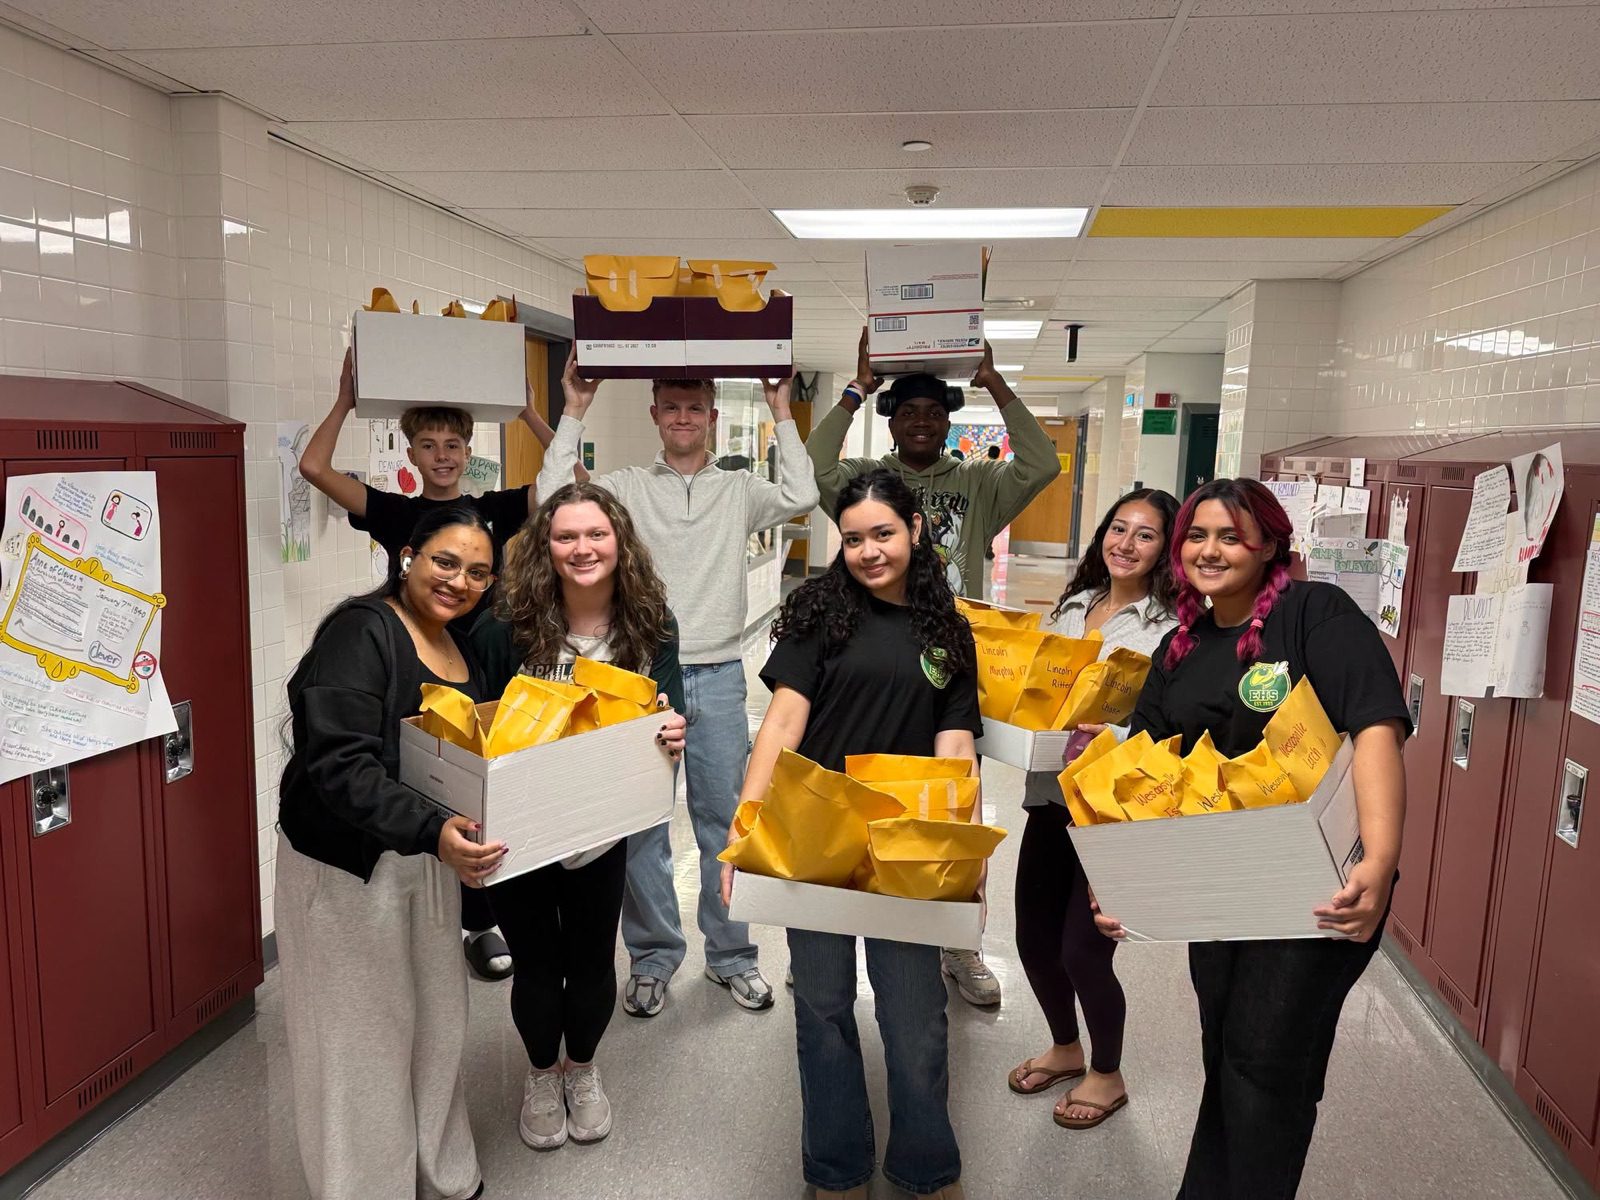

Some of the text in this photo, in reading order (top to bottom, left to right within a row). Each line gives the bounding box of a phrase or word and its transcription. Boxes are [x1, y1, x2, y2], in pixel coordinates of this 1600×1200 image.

[1310, 548, 1344, 560] ANNE
[30, 552, 77, 581] Anne of Cleves
[1335, 560, 1380, 573] BOLEYN
[96, 588, 121, 607] January
[1463, 596, 1494, 621] DEVOUT
[90, 641, 120, 664] Clever
[980, 644, 1008, 658] Lincoln
[989, 664, 1016, 682] Murphy
[1046, 659, 1073, 675] Lincoln
[1104, 671, 1132, 695] Lincoln
[1249, 689, 1279, 702] EHS
